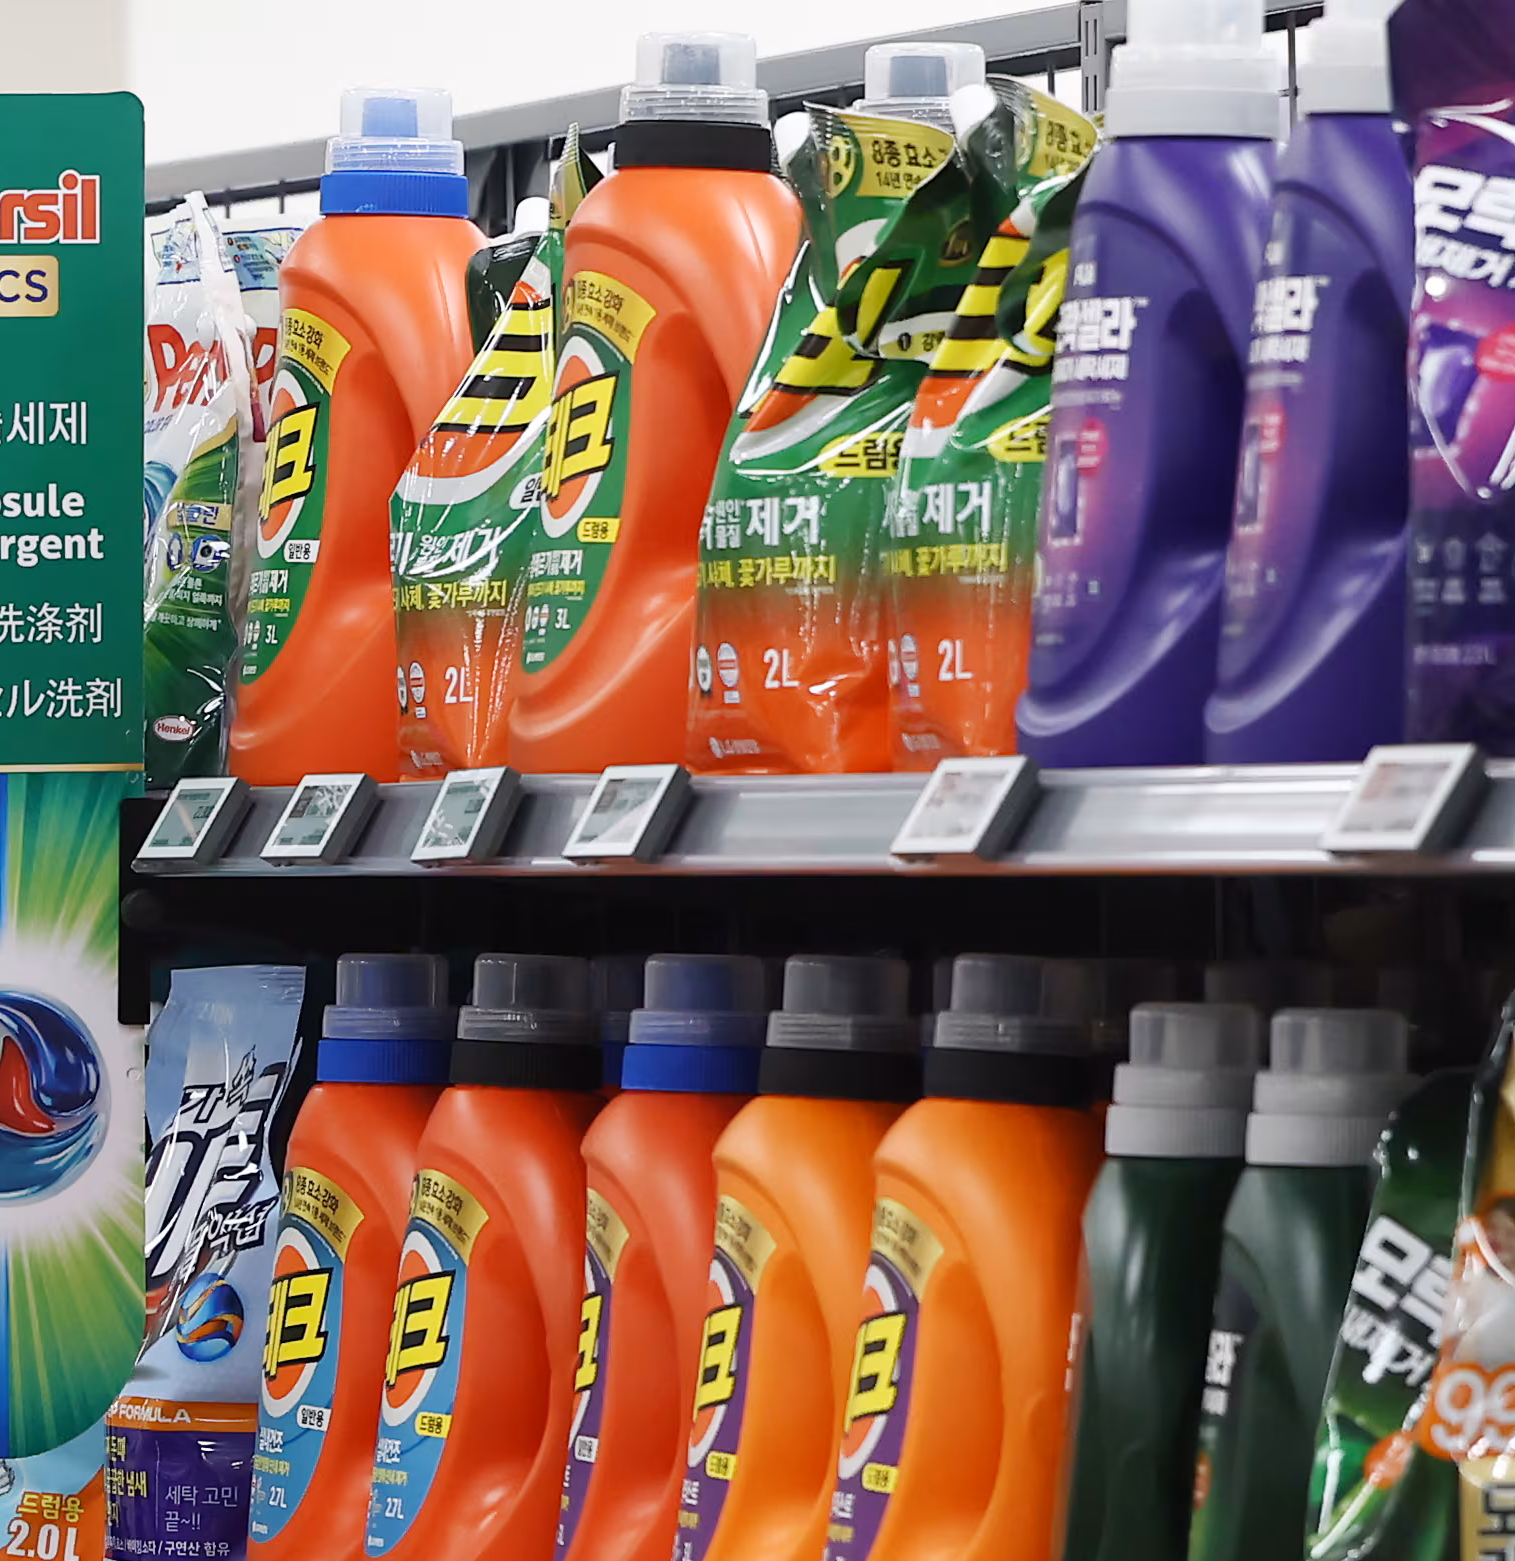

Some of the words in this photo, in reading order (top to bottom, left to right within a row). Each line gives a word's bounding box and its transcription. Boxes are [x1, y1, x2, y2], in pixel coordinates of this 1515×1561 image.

[871, 139, 901, 169] 8종
[904, 142, 938, 169] 효소
[745, 493, 822, 548] 제거
[921, 479, 994, 535] 제거
[287, 542, 312, 561] 일반용
[737, 553, 839, 589] 꽃가루까지
[426, 579, 508, 611] 꽃가루까지
[554, 607, 572, 630] 3L
[265, 624, 279, 645] 3L
[762, 647, 801, 690] 2L
[936, 637, 974, 682] 2L
[443, 666, 475, 704] 2L
[156, 718, 191, 738] Henkel
[692, 1303, 743, 1422] 크
[843, 1313, 909, 1432] 크
[118, 1404, 192, 1424] FORMULA
[300, 1406, 325, 1429] 일반용
[419, 1414, 444, 1435] 드럼용
[126, 1471, 148, 1499] 냄새
[164, 1484, 198, 1507] 세탁
[201, 1485, 239, 1508] 고민
[16, 1491, 85, 1523] 드럼용
[164, 1510, 202, 1533] 끝~!!
[164, 1541, 201, 1557] 구연산
[203, 1541, 231, 1558] 함유
